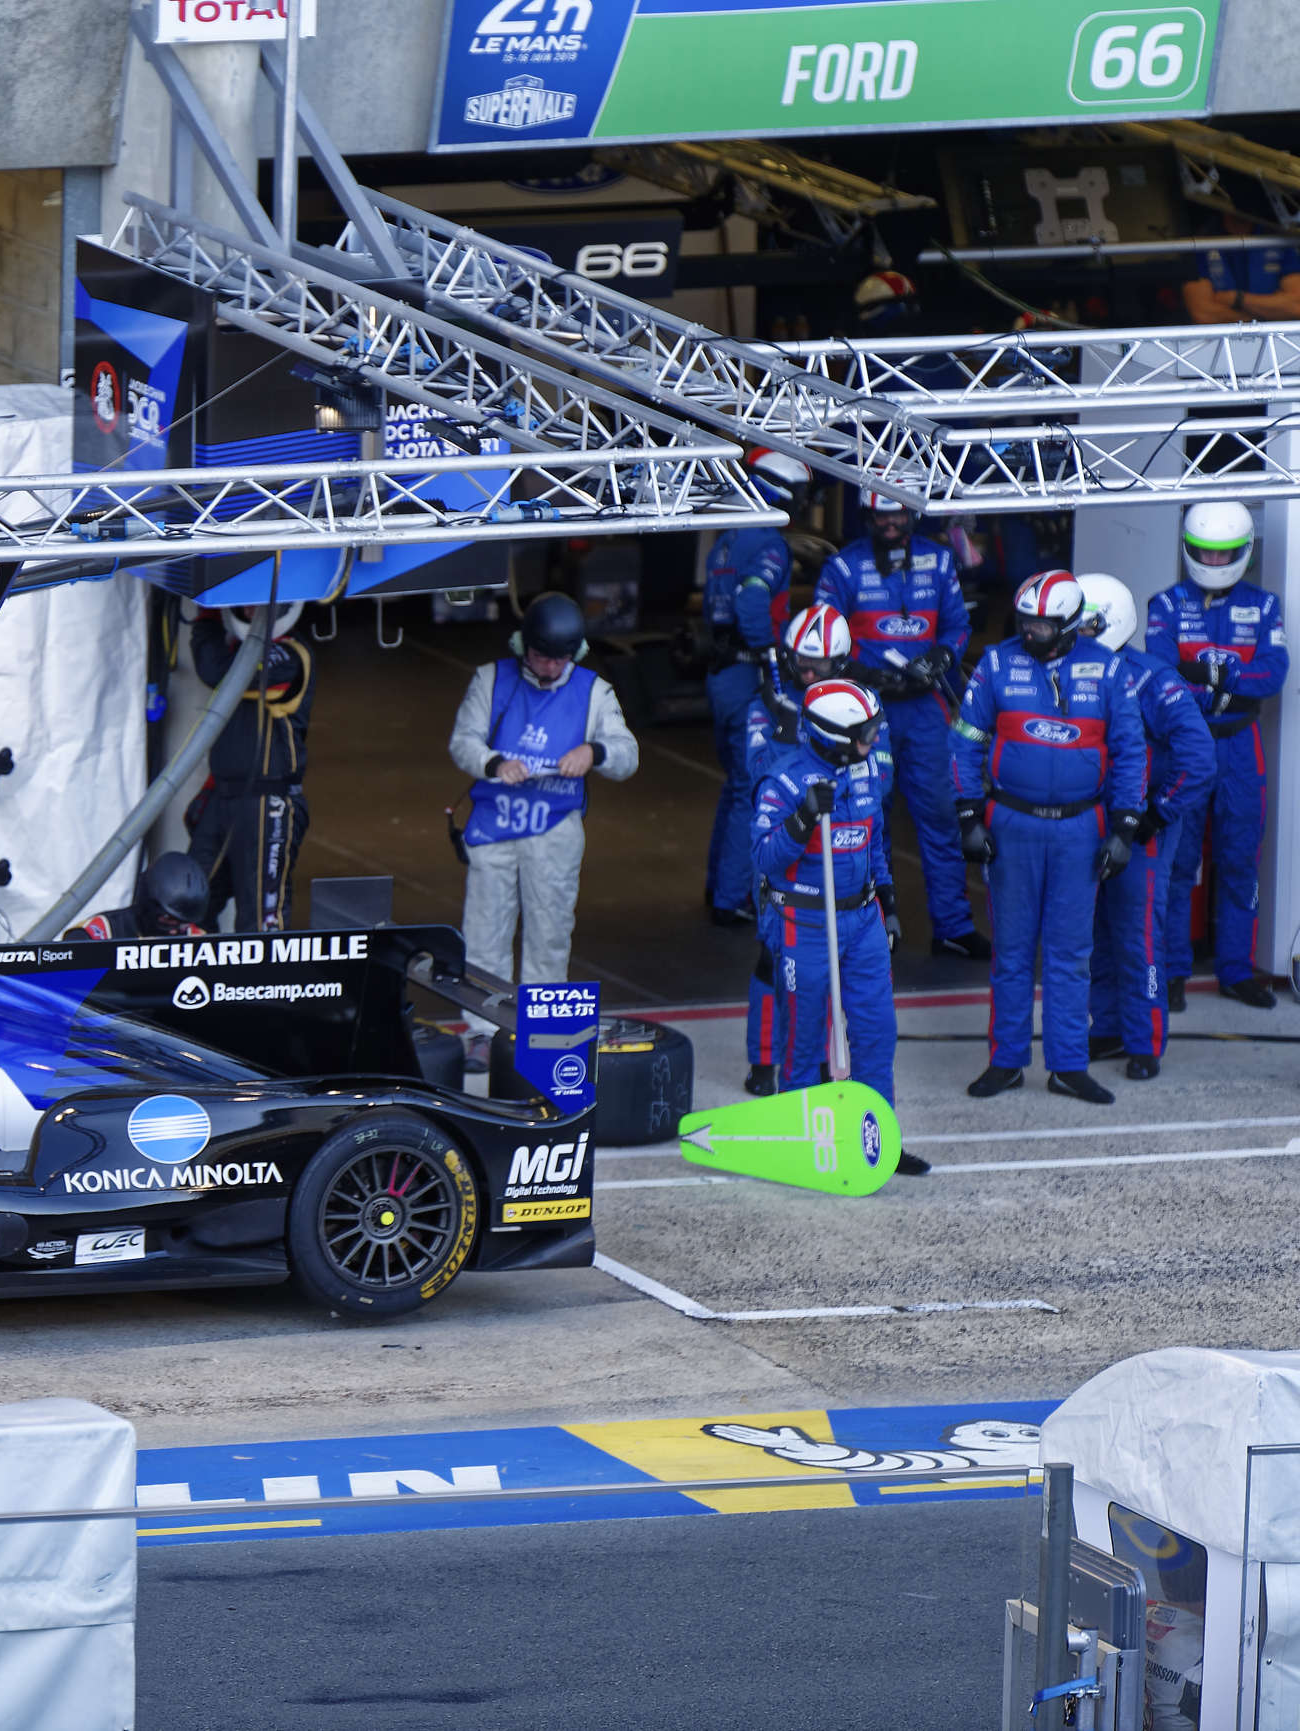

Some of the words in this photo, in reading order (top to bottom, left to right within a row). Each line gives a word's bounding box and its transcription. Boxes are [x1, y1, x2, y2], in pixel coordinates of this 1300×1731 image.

[469, 37, 504, 54] LE
[1089, 22, 1186, 90] 66
[781, 40, 919, 105] FORD
[468, 88, 574, 125] SUPERFINALE
[575, 242, 669, 279] 66
[386, 403, 448, 420] JACK
[394, 441, 441, 459] JOTA
[886, 615, 921, 634] Ford
[1033, 720, 1071, 742] Ford
[833, 829, 866, 847] Ford
[42, 950, 73, 962] Sport
[116, 940, 264, 970] RICHARD
[271, 935, 369, 962] MILLE
[1147, 964, 1158, 998] FORD
[213, 982, 342, 1002] Basecamp.com
[527, 988, 596, 1002] TOTAL
[526, 1003, 596, 1019] 道达尔
[812, 1105, 838, 1173] 66
[863, 1119, 881, 1158] Ford
[63, 1167, 163, 1195] KONICA
[171, 1160, 284, 1190] MINOLTA
[505, 1186, 532, 1198] Digital
[533, 1184, 579, 1195] Technology
[520, 1204, 587, 1217] DUNLOP
[91, 1232, 143, 1250] WEC
